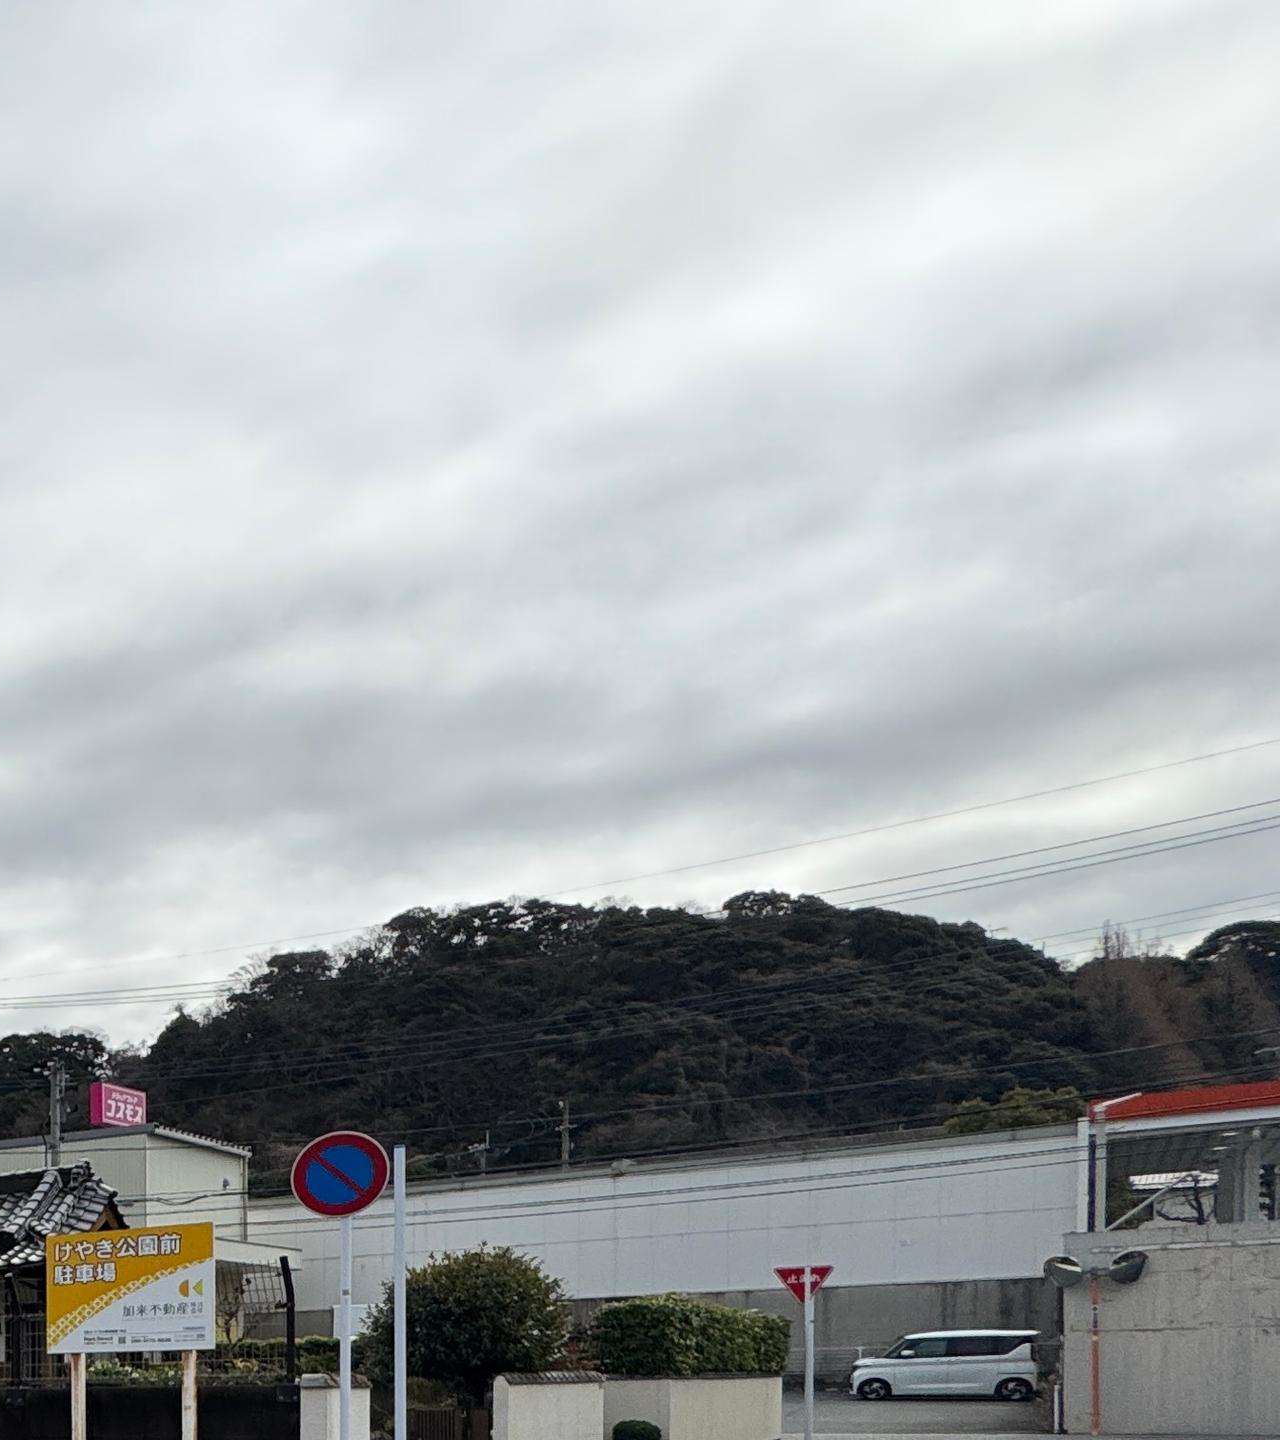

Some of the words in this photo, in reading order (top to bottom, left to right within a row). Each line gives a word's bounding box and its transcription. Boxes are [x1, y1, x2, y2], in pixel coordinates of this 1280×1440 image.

[106, 1099, 142, 1123] コスモス
[54, 1233, 182, 1262] けやき公園前
[54, 1262, 117, 1285] 駐車場
